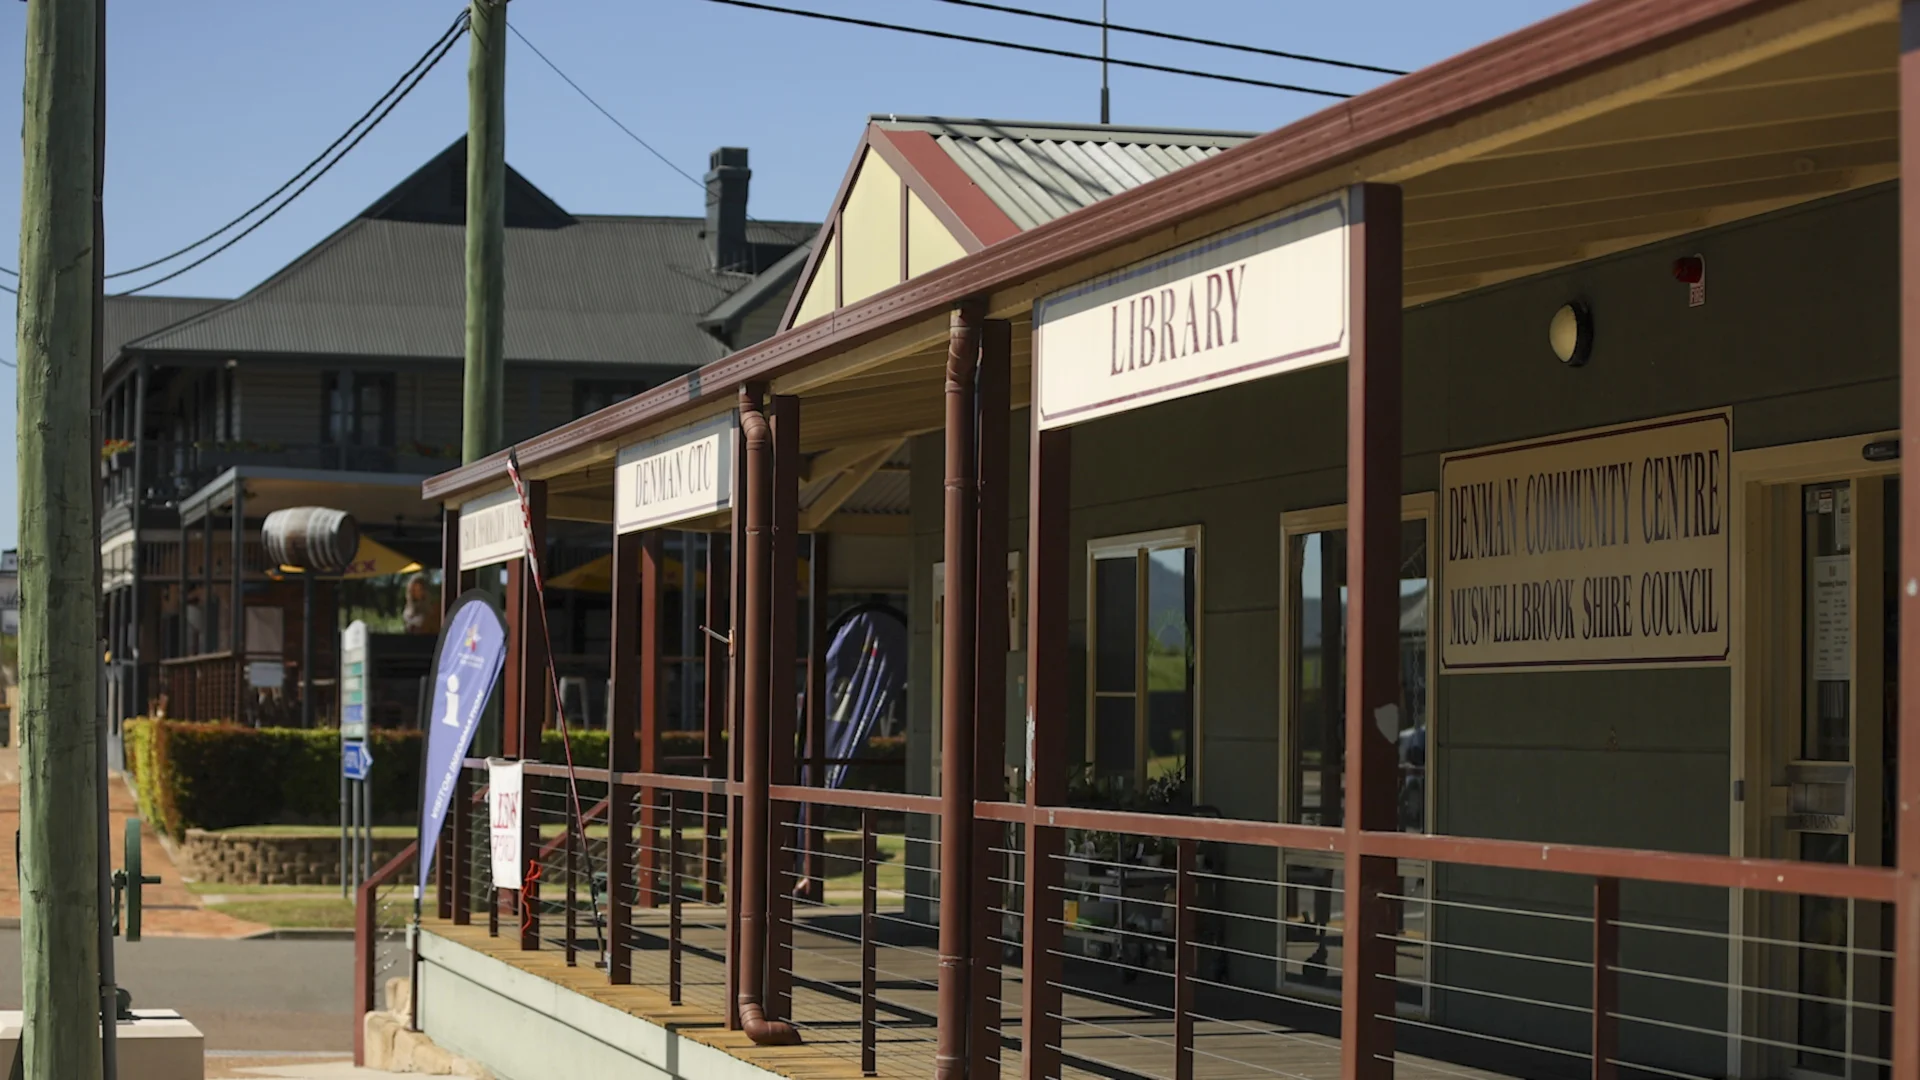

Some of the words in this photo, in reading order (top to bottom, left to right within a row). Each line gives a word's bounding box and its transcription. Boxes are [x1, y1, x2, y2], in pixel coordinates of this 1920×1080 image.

[1110, 264, 1246, 376] LIBRARY
[635, 450, 684, 508] DENMAN
[688, 440, 712, 495] CTC
[1449, 477, 1518, 562] DENMAN
[1525, 461, 1633, 556] COMMUNITY
[1642, 450, 1721, 545] CENTRE
[1449, 579, 1576, 646] MUSWELLBROOK
[1582, 575, 1633, 640] SHIRE
[1640, 568, 1719, 637] COUNCIL
[430, 771, 454, 820] VISITOR
[449, 689, 484, 775] INFORMATION
